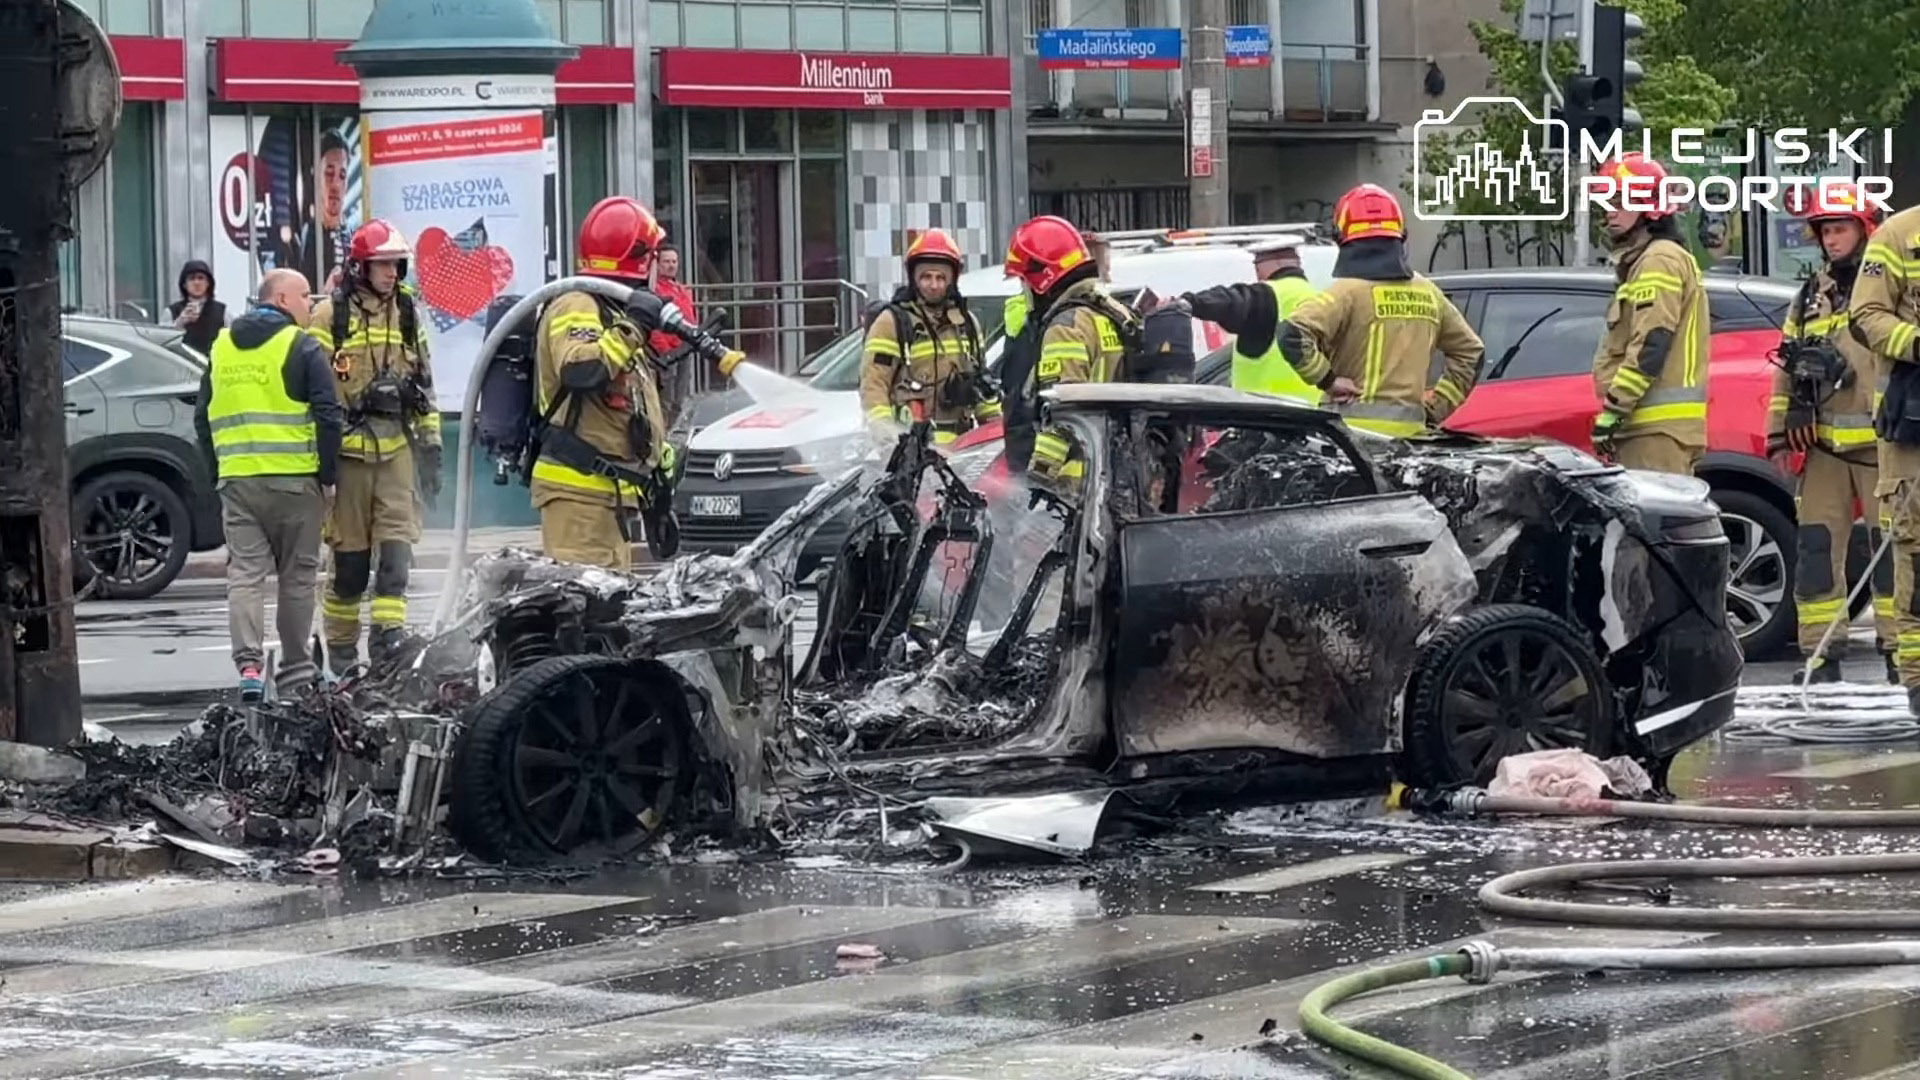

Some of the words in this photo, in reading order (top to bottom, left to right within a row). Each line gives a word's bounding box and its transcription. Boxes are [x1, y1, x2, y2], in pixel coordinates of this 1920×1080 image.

[1059, 37, 1156, 59] Madalińskiego
[801, 53, 892, 88] Millennium
[864, 90, 884, 105] bank
[402, 177, 503, 200] SZABASOWA
[404, 193, 511, 212] DZIEWCZYNA
